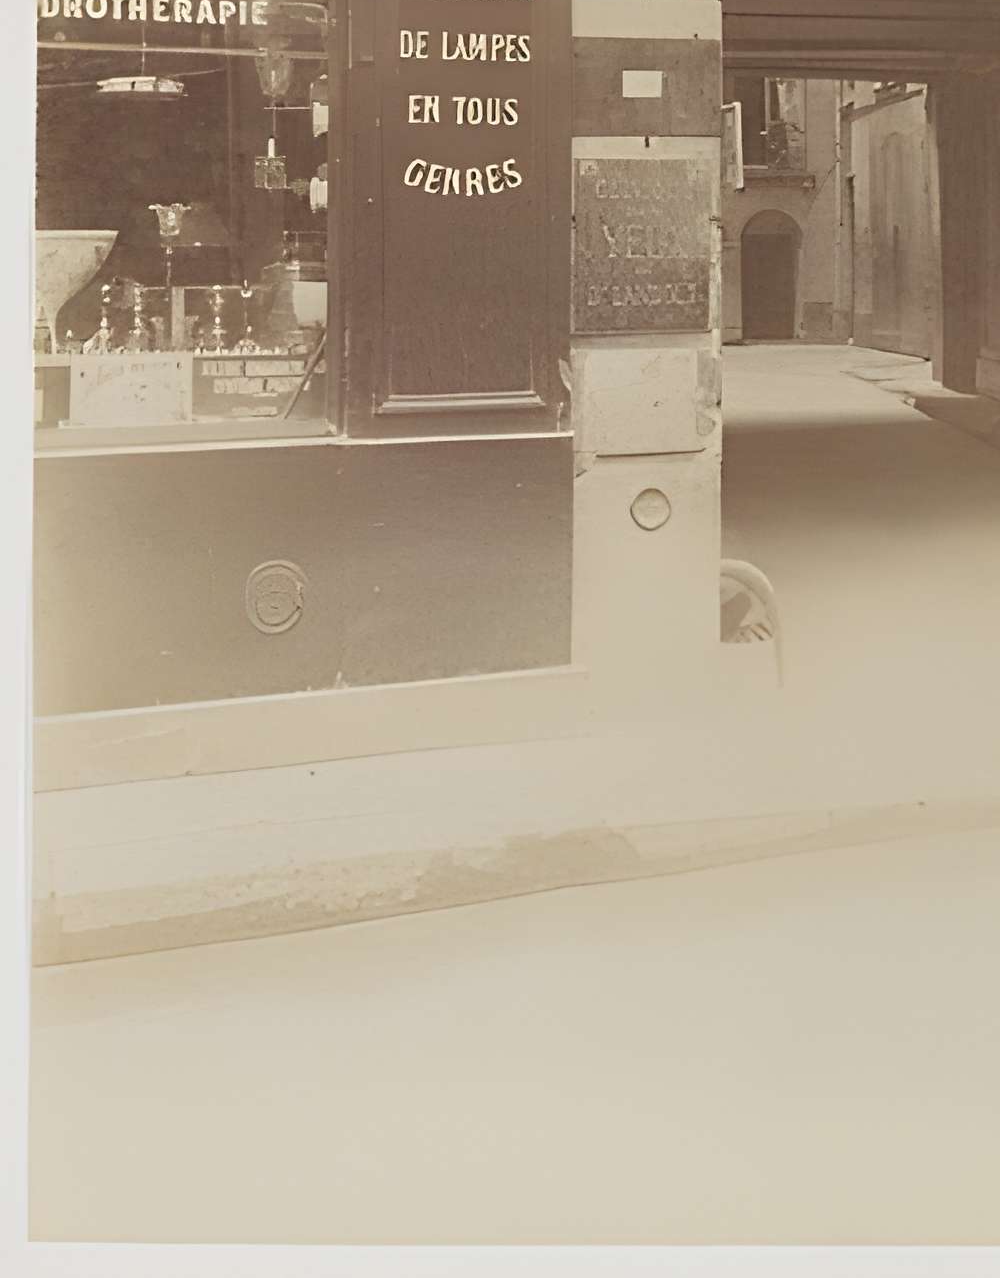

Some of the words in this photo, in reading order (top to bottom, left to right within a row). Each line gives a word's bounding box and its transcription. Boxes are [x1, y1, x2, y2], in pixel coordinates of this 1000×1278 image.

[399, 30, 430, 60] DE
[441, 31, 531, 63] LAMPES
[408, 95, 441, 124] EN
[452, 96, 520, 127] TOUS
[404, 158, 523, 197] GENRES
